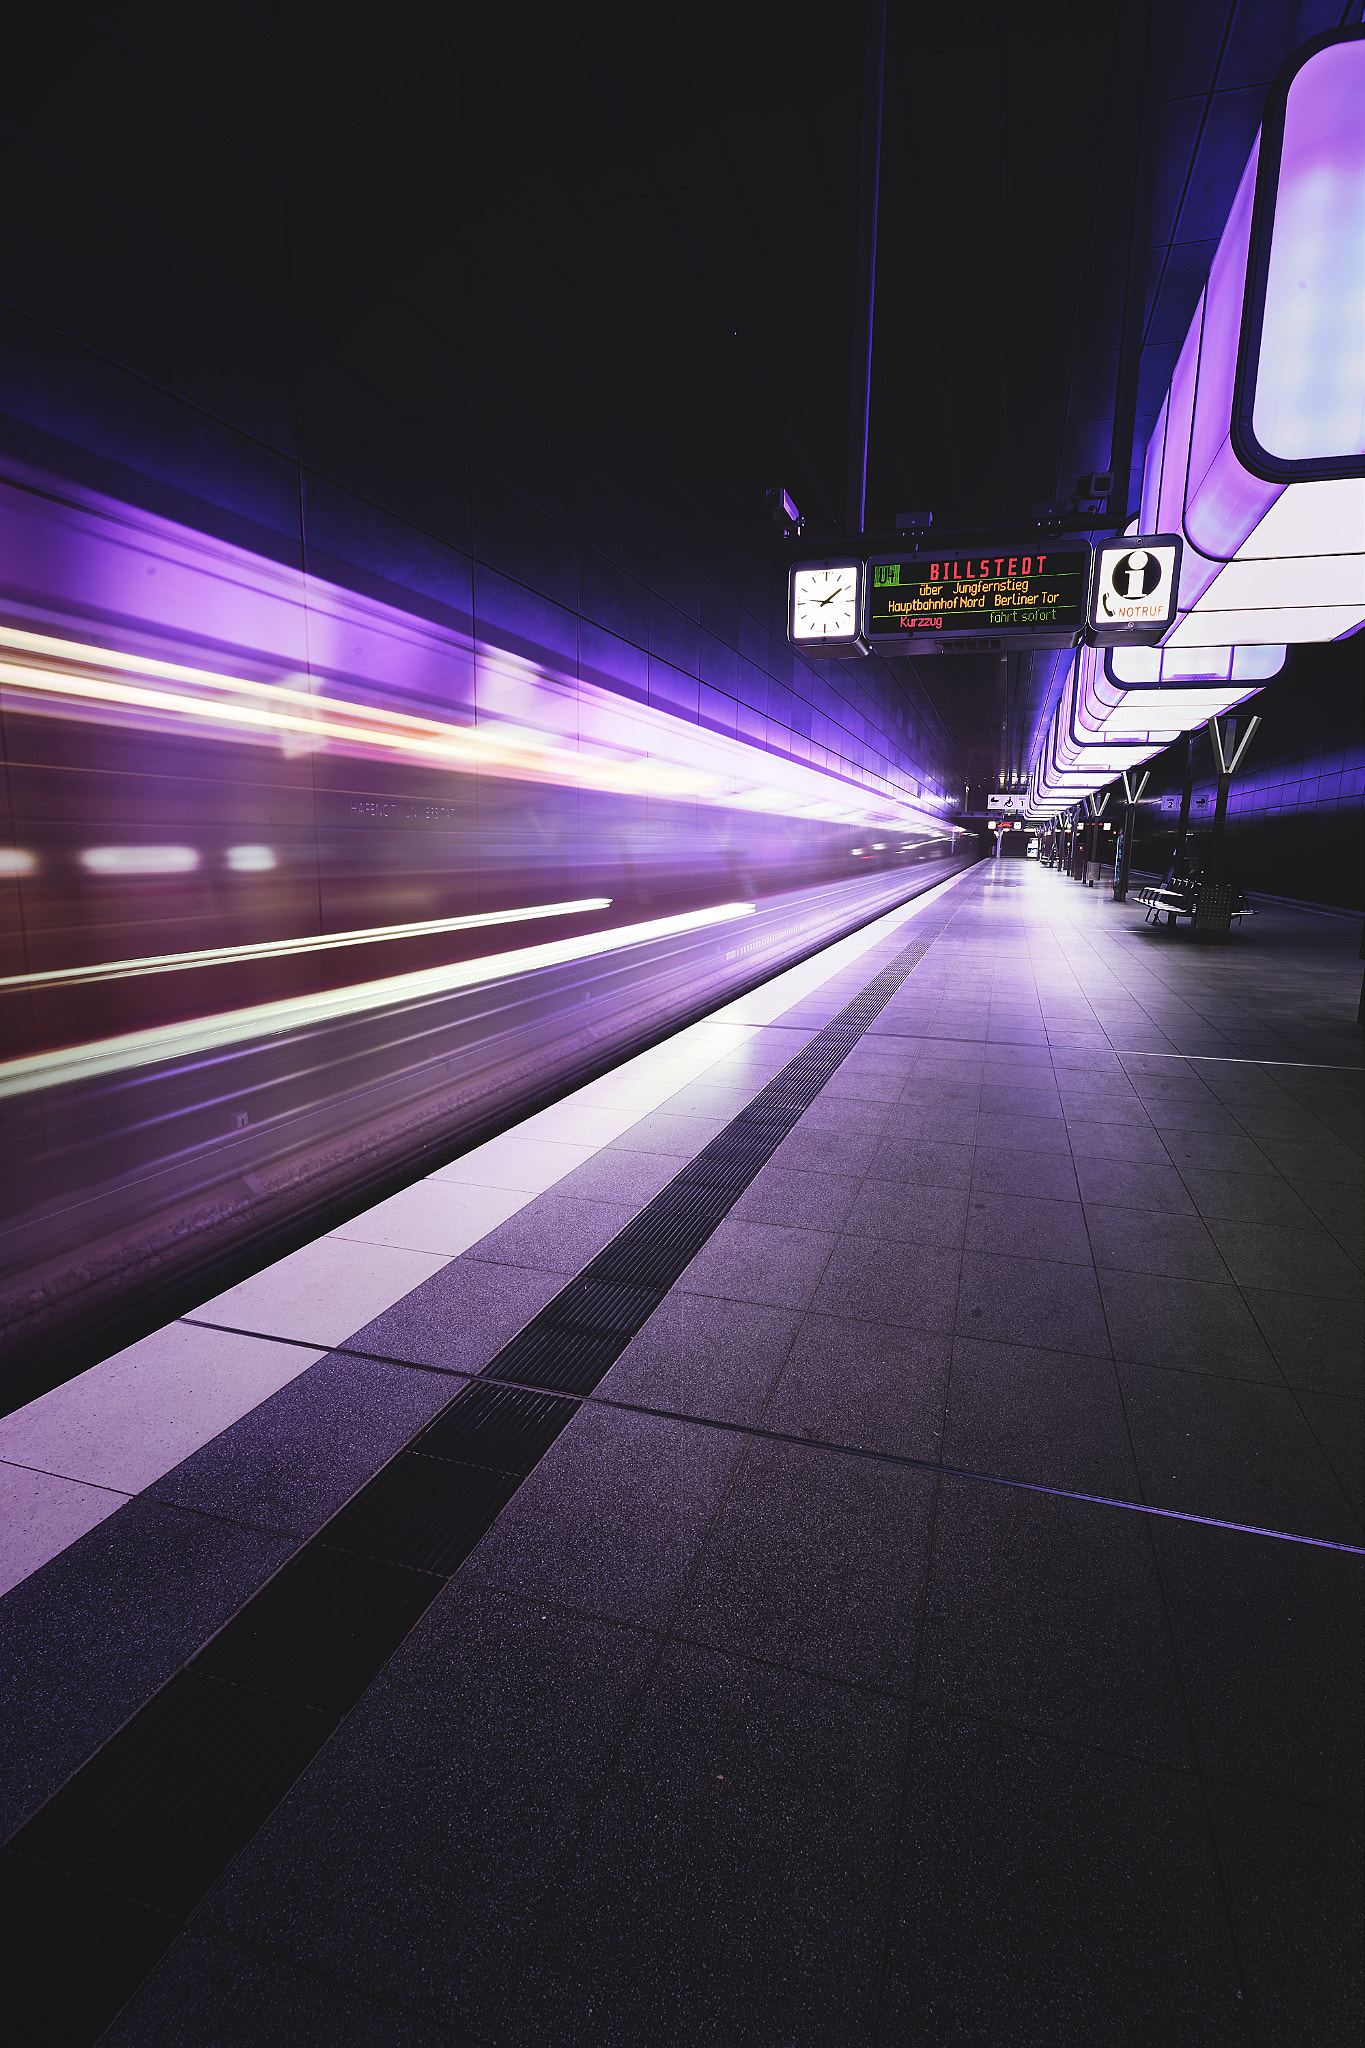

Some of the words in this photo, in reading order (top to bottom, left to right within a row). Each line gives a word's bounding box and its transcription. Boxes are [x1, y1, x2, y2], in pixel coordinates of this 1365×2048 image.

[879, 566, 895, 584] U4
[930, 556, 1046, 580] BILLSTEDT
[920, 584, 943, 596] über
[953, 579, 1029, 596] Jungfernstieg
[888, 597, 959, 614] Hauptbahnhof
[959, 594, 985, 608] Nord
[995, 593, 1039, 607] Berliner
[1042, 591, 1059, 604] Tor
[1118, 605, 1164, 617] NOTRUF
[900, 616, 942, 629] Kurzzug
[990, 611, 1018, 623] fährt
[1022, 609, 1056, 622] sofort
